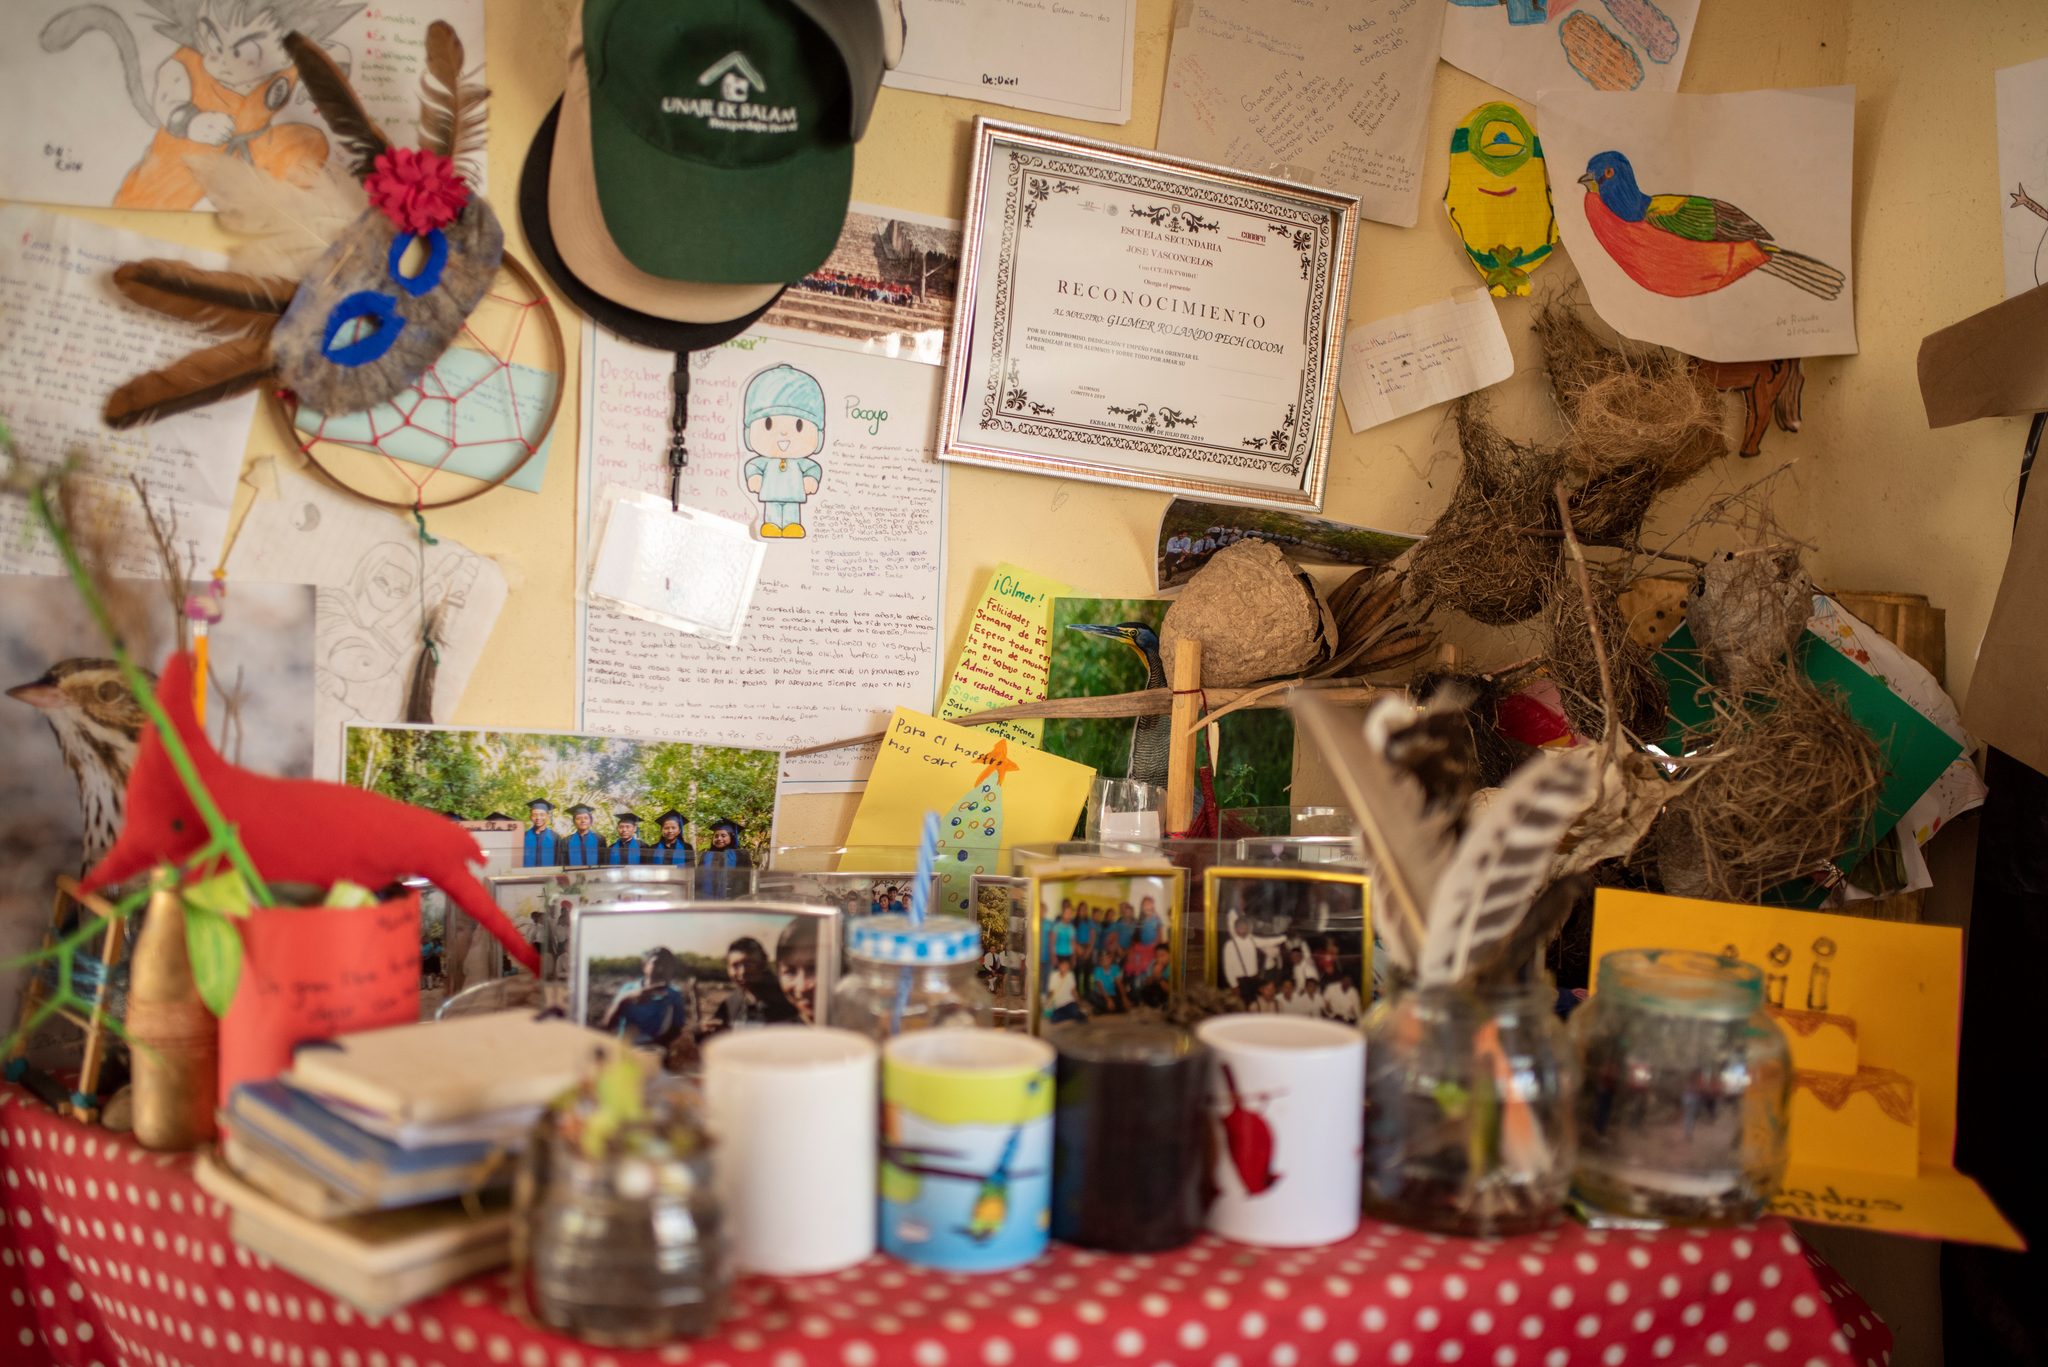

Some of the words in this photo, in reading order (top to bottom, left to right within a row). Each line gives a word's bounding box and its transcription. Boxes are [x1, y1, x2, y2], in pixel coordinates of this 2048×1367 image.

[717, 103, 737, 118] EK
[740, 103, 797, 123] BALAM
[1120, 226, 1162, 241] ESCUELA
[1165, 234, 1222, 252] SECUNDARIA
[1126, 245, 1149, 257] JOSE
[1150, 249, 1213, 267] VASCONCELOS
[1144, 279, 1162, 288] Otorga
[1169, 283, 1191, 291] presente
[1058, 280, 1266, 328] RECONOCIMIENTO
[1107, 315, 1156, 333] GILMER
[1156, 322, 1213, 341] ROLANDO
[1214, 331, 1247, 347] PECH
[1246, 338, 1284, 354] COCOM
[1027, 335, 1063, 346] APRENDIZAJE
[1084, 344, 1109, 354] ALUMNOS
[1116, 350, 1133, 358] SOBRE
[1165, 350, 1192, 360] ORIENTAR
[844, 395, 889, 435] Pocoyo
[1164, 430, 1179, 438] JULIO
[987, 597, 1030, 627] Felicidades
[976, 608, 1011, 631] Semana
[1018, 629, 1029, 639] de
[974, 623, 1005, 642] Espero
[1009, 639, 1033, 654] todos
[983, 642, 1003, 654] sean
[1008, 651, 1018, 661] de
[954, 671, 968, 684] tus
[974, 681, 1014, 701] resultados
[961, 658, 994, 678] Admiro
[998, 677, 1022, 690] mucho
[1025, 685, 1033, 695] tu
[1023, 672, 1036, 681] con
[943, 709, 953, 717] en
[947, 698, 972, 714] Sabes
[896, 717, 926, 738] Para
[986, 726, 1016, 742] confiar
[1013, 725, 1035, 739] tienes
